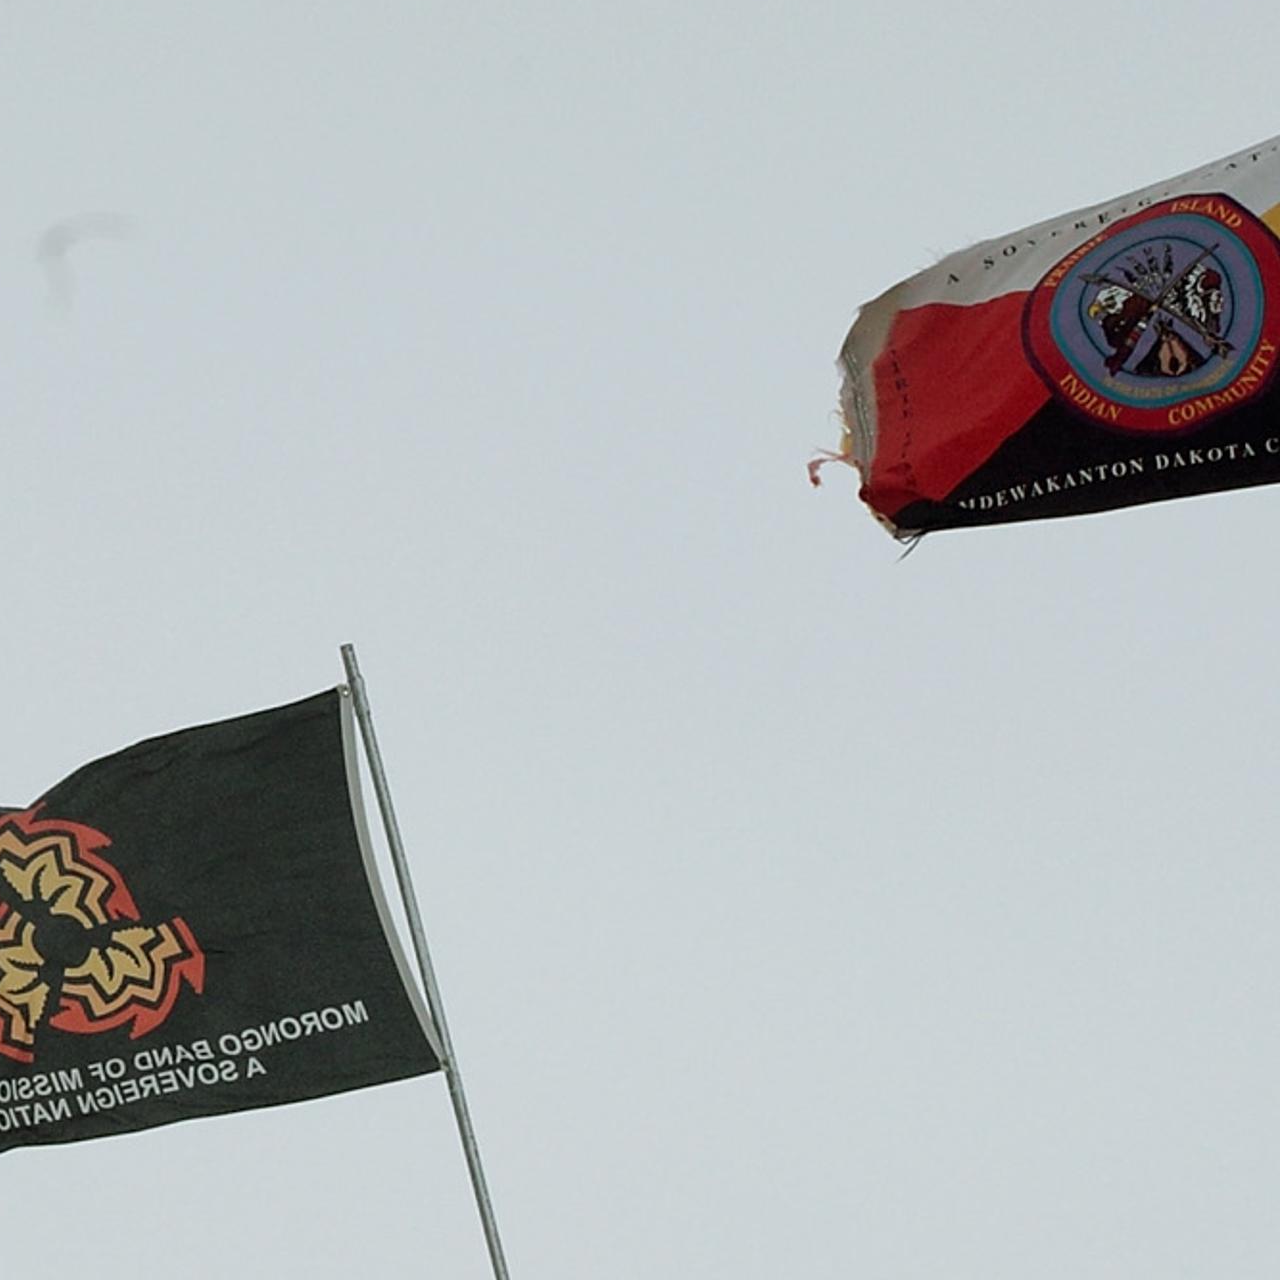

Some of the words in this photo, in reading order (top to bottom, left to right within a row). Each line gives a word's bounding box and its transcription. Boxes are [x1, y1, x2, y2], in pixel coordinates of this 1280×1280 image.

[1169, 199, 1243, 229] ISLAND
[1059, 373, 1123, 421] INDIAN
[1168, 338, 1277, 425] COMMUNITY
[1155, 441, 1256, 470] DAKOTA
